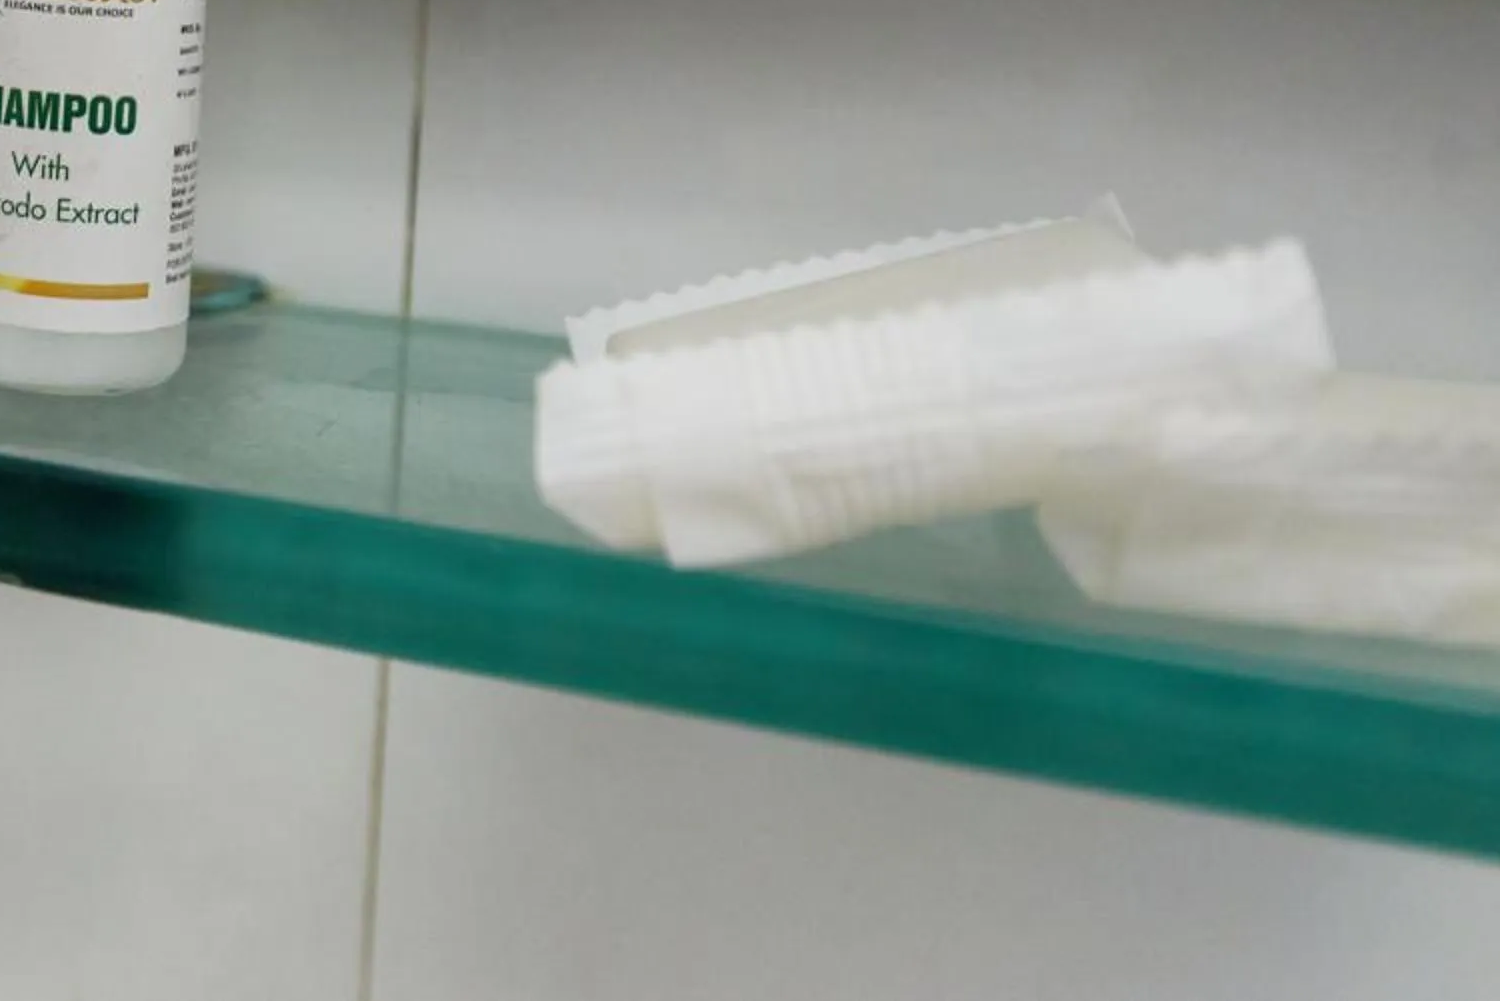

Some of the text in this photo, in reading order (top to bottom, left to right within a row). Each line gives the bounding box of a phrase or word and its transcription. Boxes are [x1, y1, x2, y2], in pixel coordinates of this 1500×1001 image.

[3, 0, 134, 18] ELEGANCE IS OUR CHOICE
[11, 150, 70, 181] With
[56, 198, 140, 225] Extract
